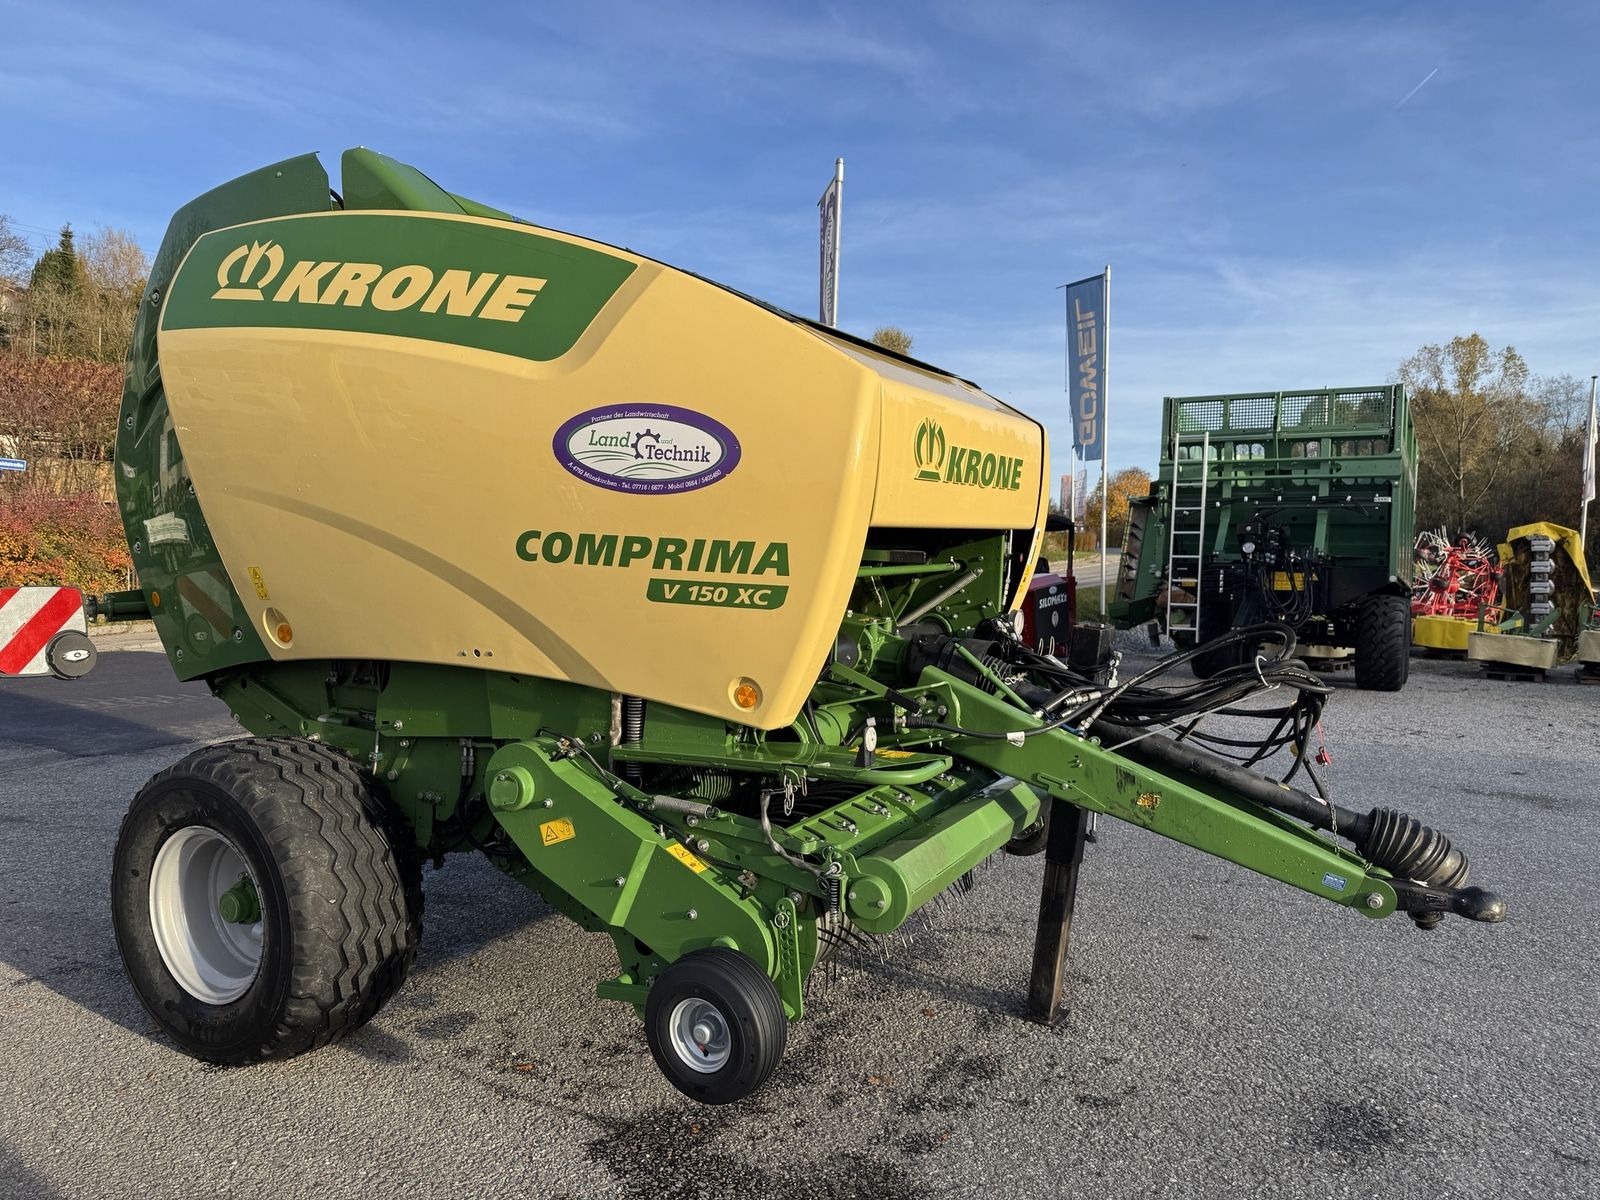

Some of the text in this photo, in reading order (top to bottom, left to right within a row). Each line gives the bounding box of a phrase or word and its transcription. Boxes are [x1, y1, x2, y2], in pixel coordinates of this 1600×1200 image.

[272, 260, 548, 323] KRONE
[591, 410, 669, 423] Partner der Landwirtschaft
[589, 429, 711, 463] Land und Technik
[945, 445, 1024, 490] KRONE
[667, 482, 685, 490] Mobil
[515, 529, 790, 577] COMPRIMA
[663, 583, 772, 606] V 150 XC
